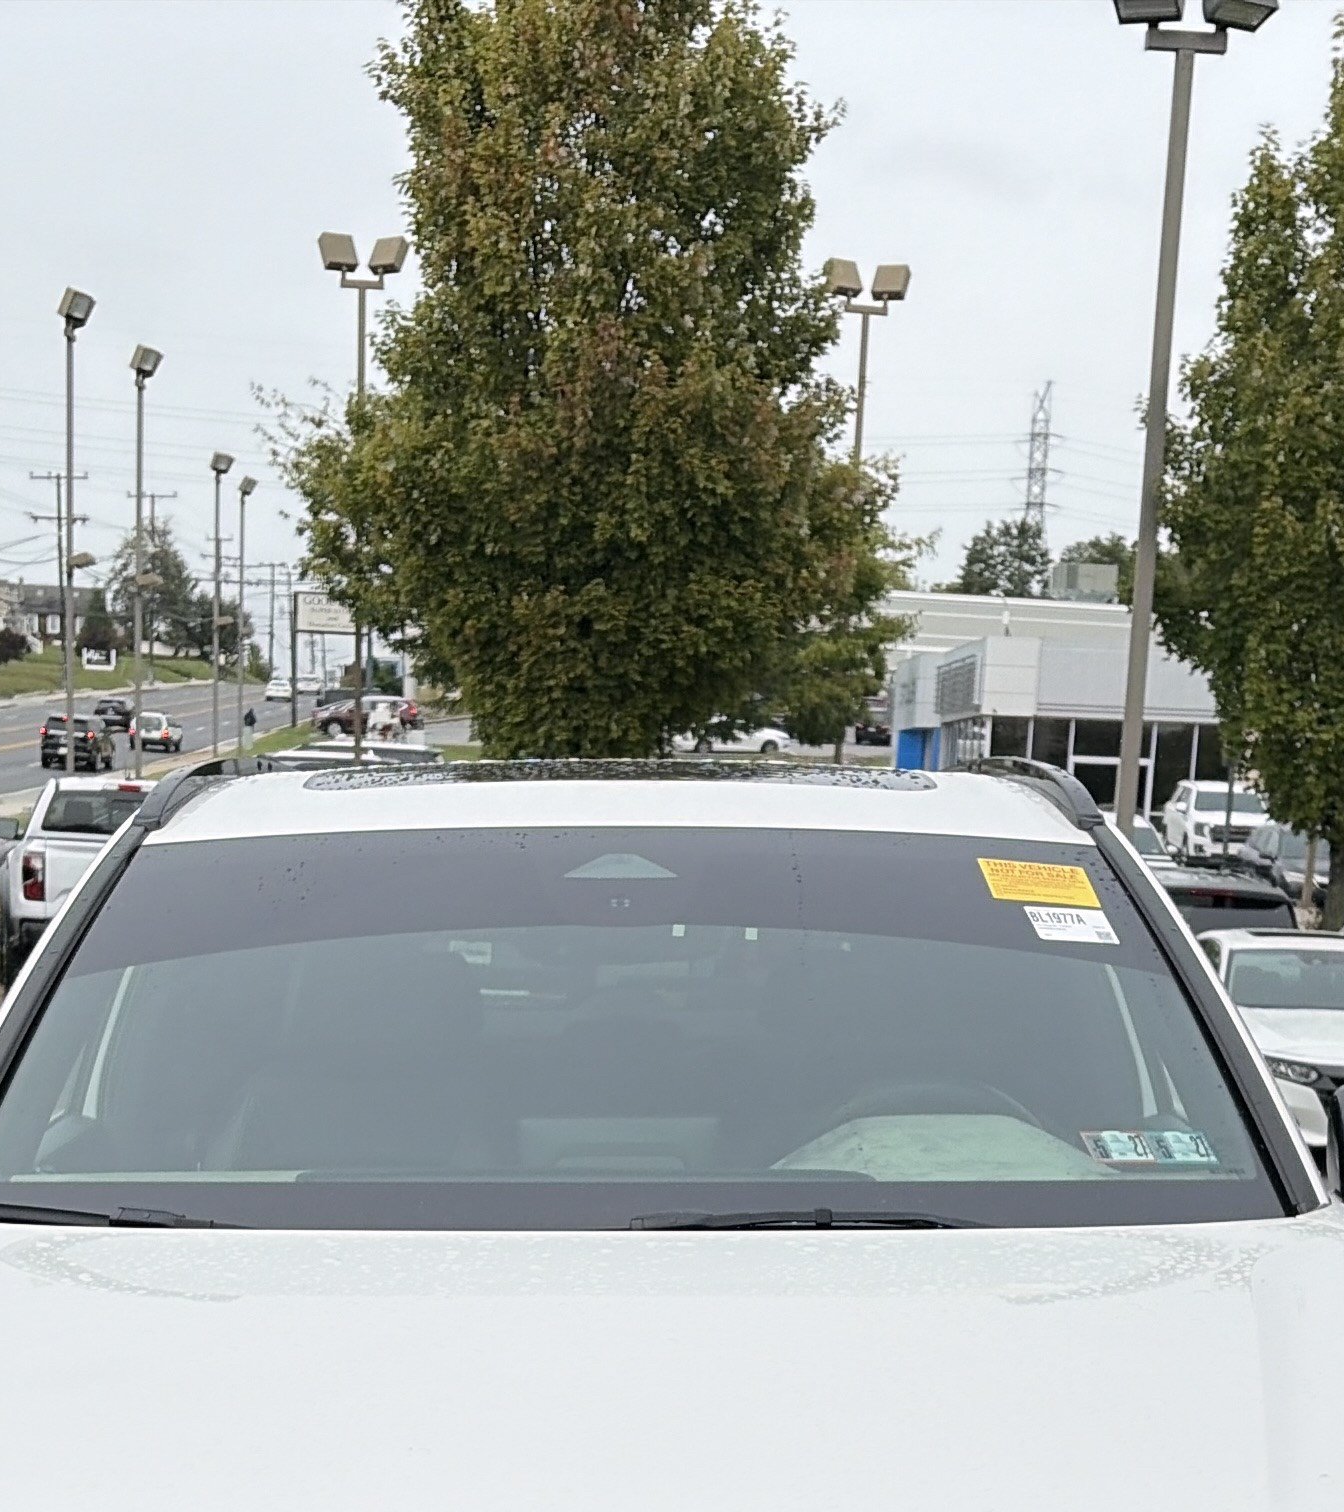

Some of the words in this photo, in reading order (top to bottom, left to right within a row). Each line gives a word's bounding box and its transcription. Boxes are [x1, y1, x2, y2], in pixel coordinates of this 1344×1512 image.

[985, 860, 1017, 869] THIS
[1019, 863, 1080, 875] VEHICLE
[990, 867, 1017, 875] NOT
[1019, 868, 1043, 877] FOR
[1045, 871, 1078, 880] SALE
[1028, 911, 1087, 926] BL1977A
